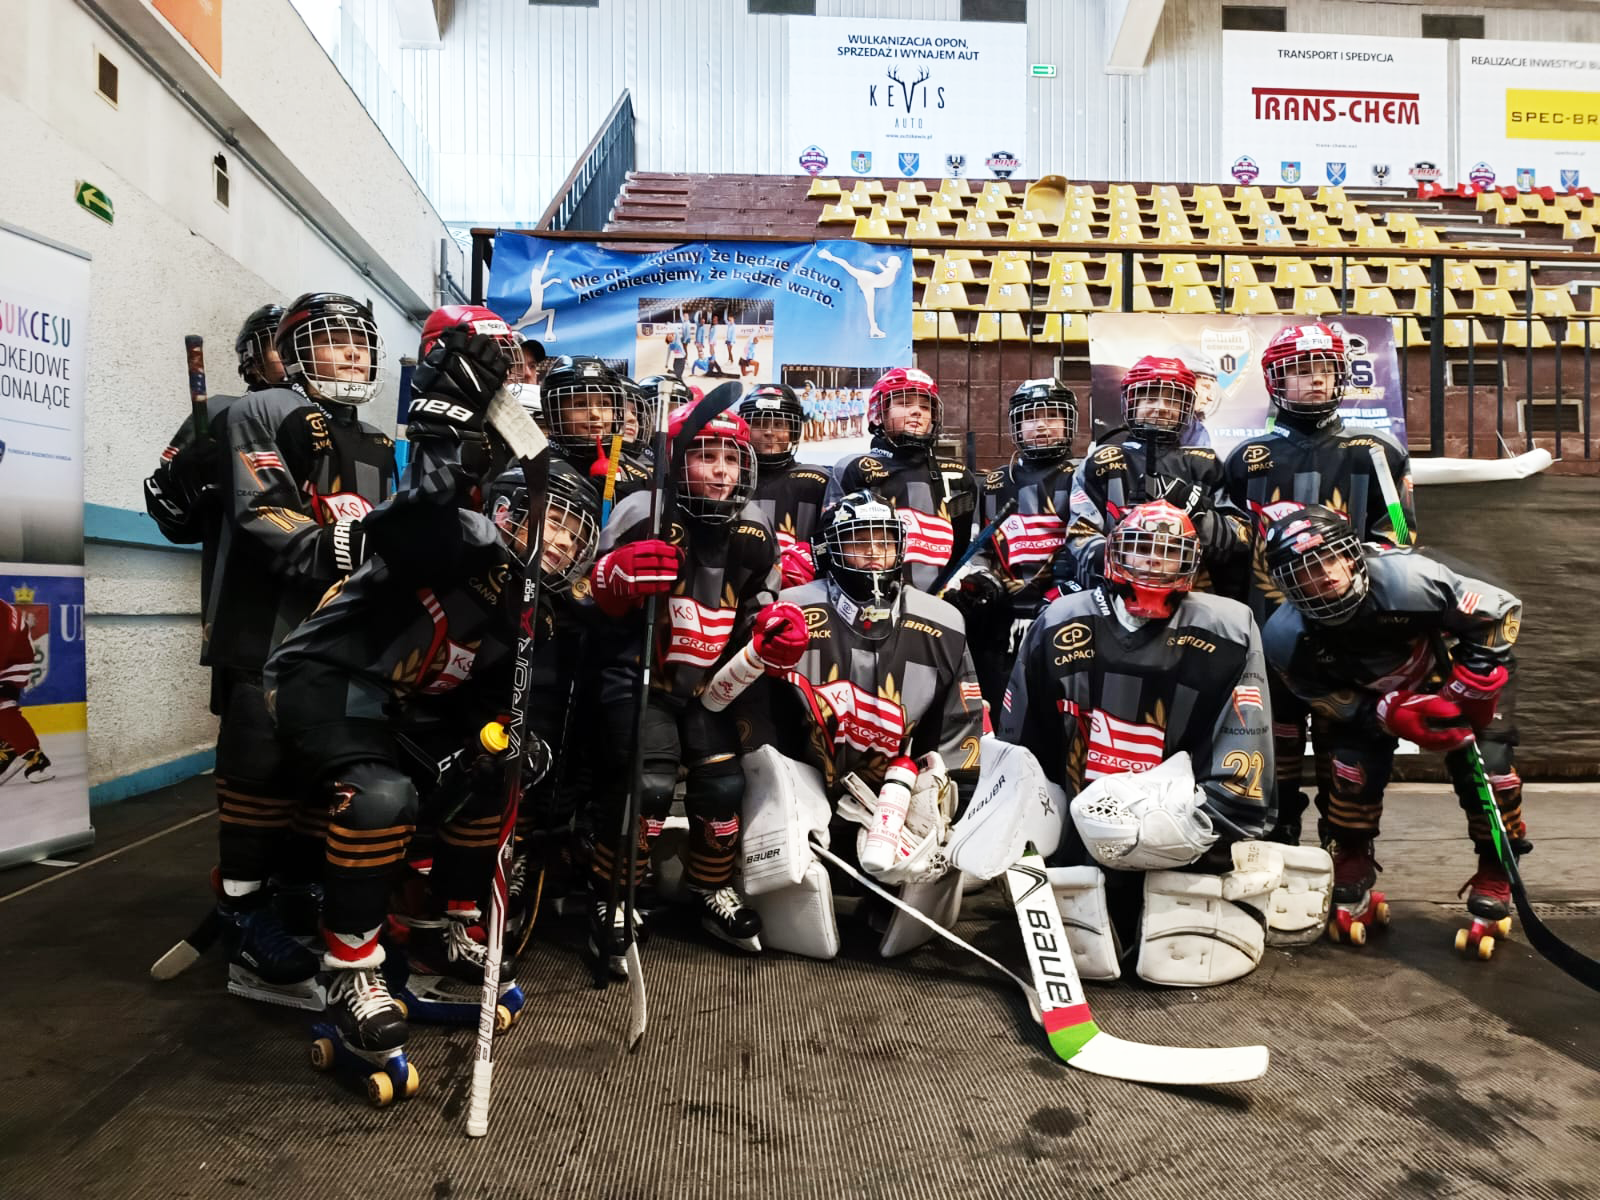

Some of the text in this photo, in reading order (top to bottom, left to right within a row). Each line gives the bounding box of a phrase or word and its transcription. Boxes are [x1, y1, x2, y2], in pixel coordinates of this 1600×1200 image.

[848, 34, 969, 49] WULKANIZACJA OPON,
[837, 46, 980, 61] SPRZEDAŻ I WYNAJEM AUT
[1277, 49, 1395, 63] TRANSPORT I SPEDYCJA
[1471, 55, 1528, 67] REALIZACJE
[870, 82, 945, 114] KEVIS
[1251, 87, 1420, 125] TRANS-CHEM
[895, 118, 923, 129] AUTO
[1511, 111, 1599, 125] SPEC-BR
[569, 274, 601, 290] Nie
[711, 248, 731, 263] że
[734, 251, 791, 273] będzie
[607, 268, 705, 293] obiecujemy,
[709, 266, 728, 280] że
[731, 268, 783, 288] będzie
[786, 280, 835, 309] warto.
[0, 299, 71, 348] UKCESU
[335, 502, 361, 518] KS
[673, 603, 694, 621] KS
[1026, 908, 1073, 1011] BAUE
